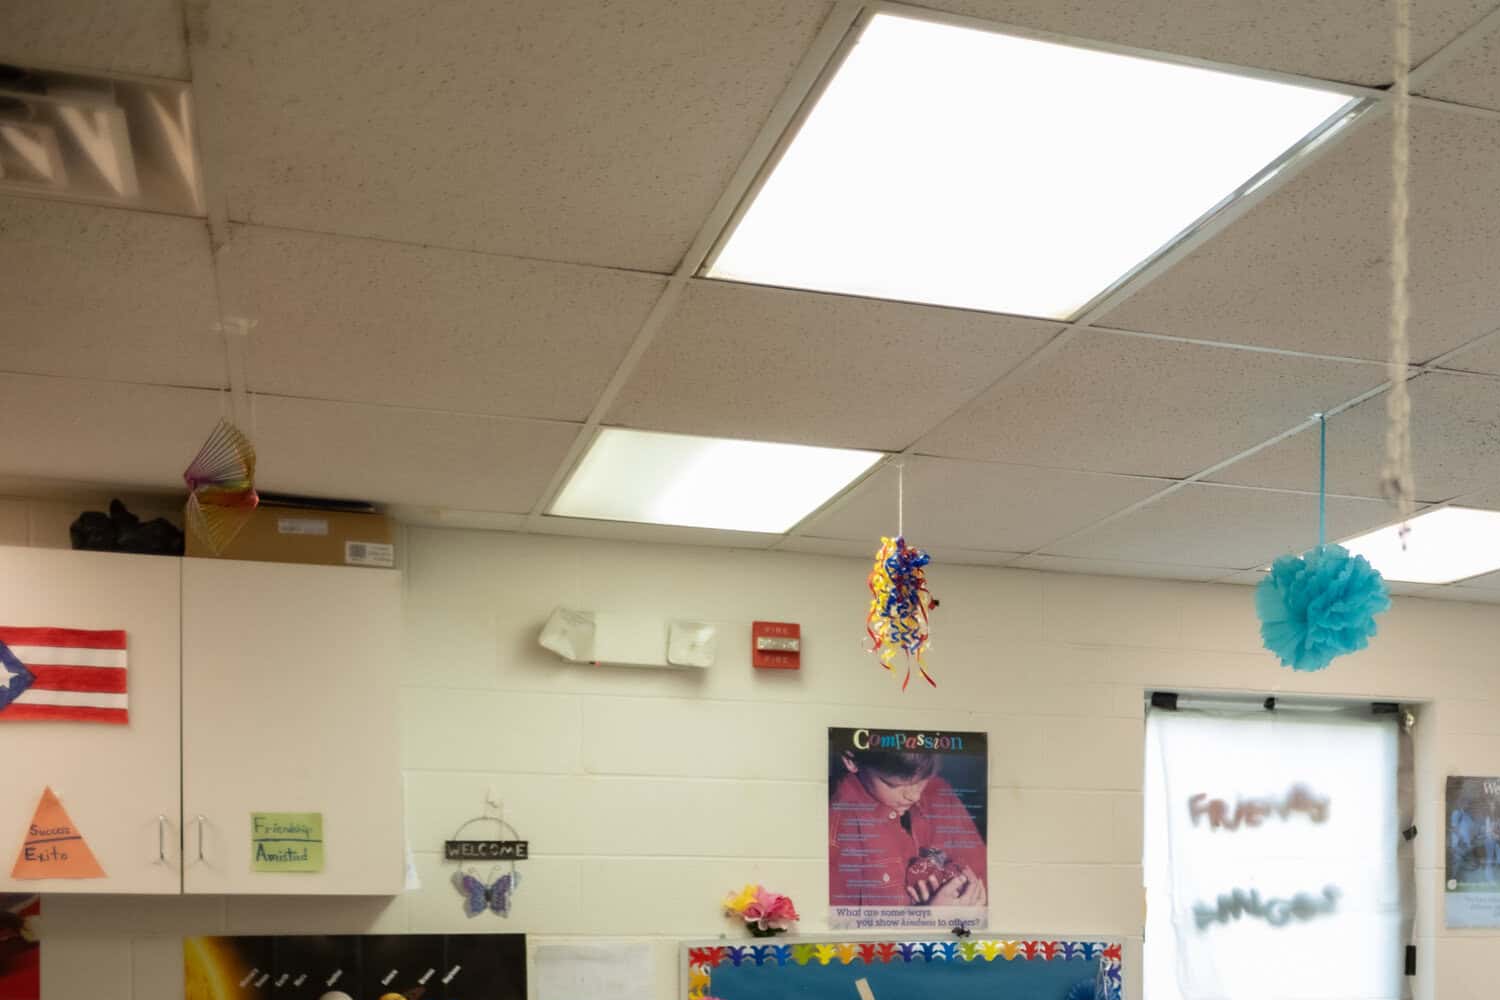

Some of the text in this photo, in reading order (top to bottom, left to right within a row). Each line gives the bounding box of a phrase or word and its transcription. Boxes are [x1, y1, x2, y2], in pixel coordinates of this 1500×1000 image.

[853, 728, 963, 752] Compassion
[255, 843, 309, 862] Amistad
[447, 841, 527, 859] WELCOME
[836, 908, 861, 919] What
[856, 919, 873, 929] you
[876, 918, 899, 926] show
[938, 918, 946, 926] to
